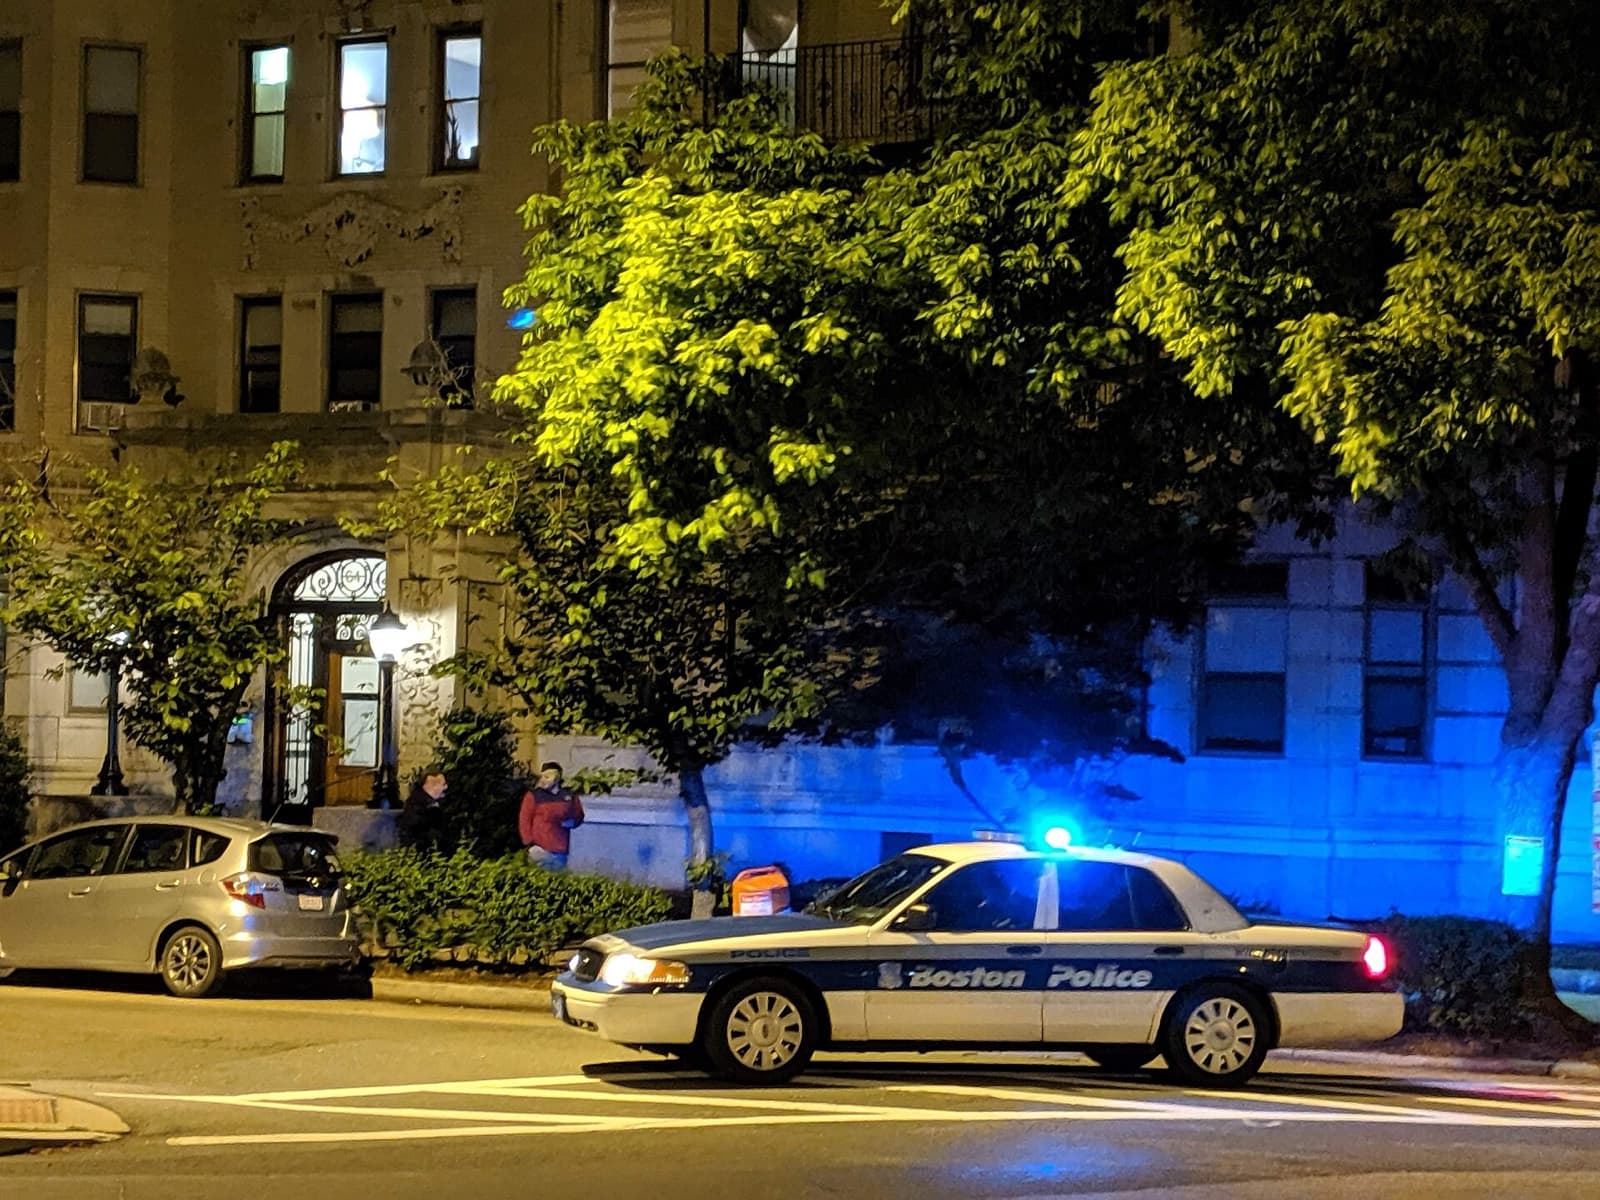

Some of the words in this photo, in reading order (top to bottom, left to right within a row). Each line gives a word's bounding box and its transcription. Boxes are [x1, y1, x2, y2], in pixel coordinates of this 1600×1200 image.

[730, 948, 810, 958] POLICE
[909, 965, 1025, 988] Boston
[1047, 964, 1152, 988] Police
